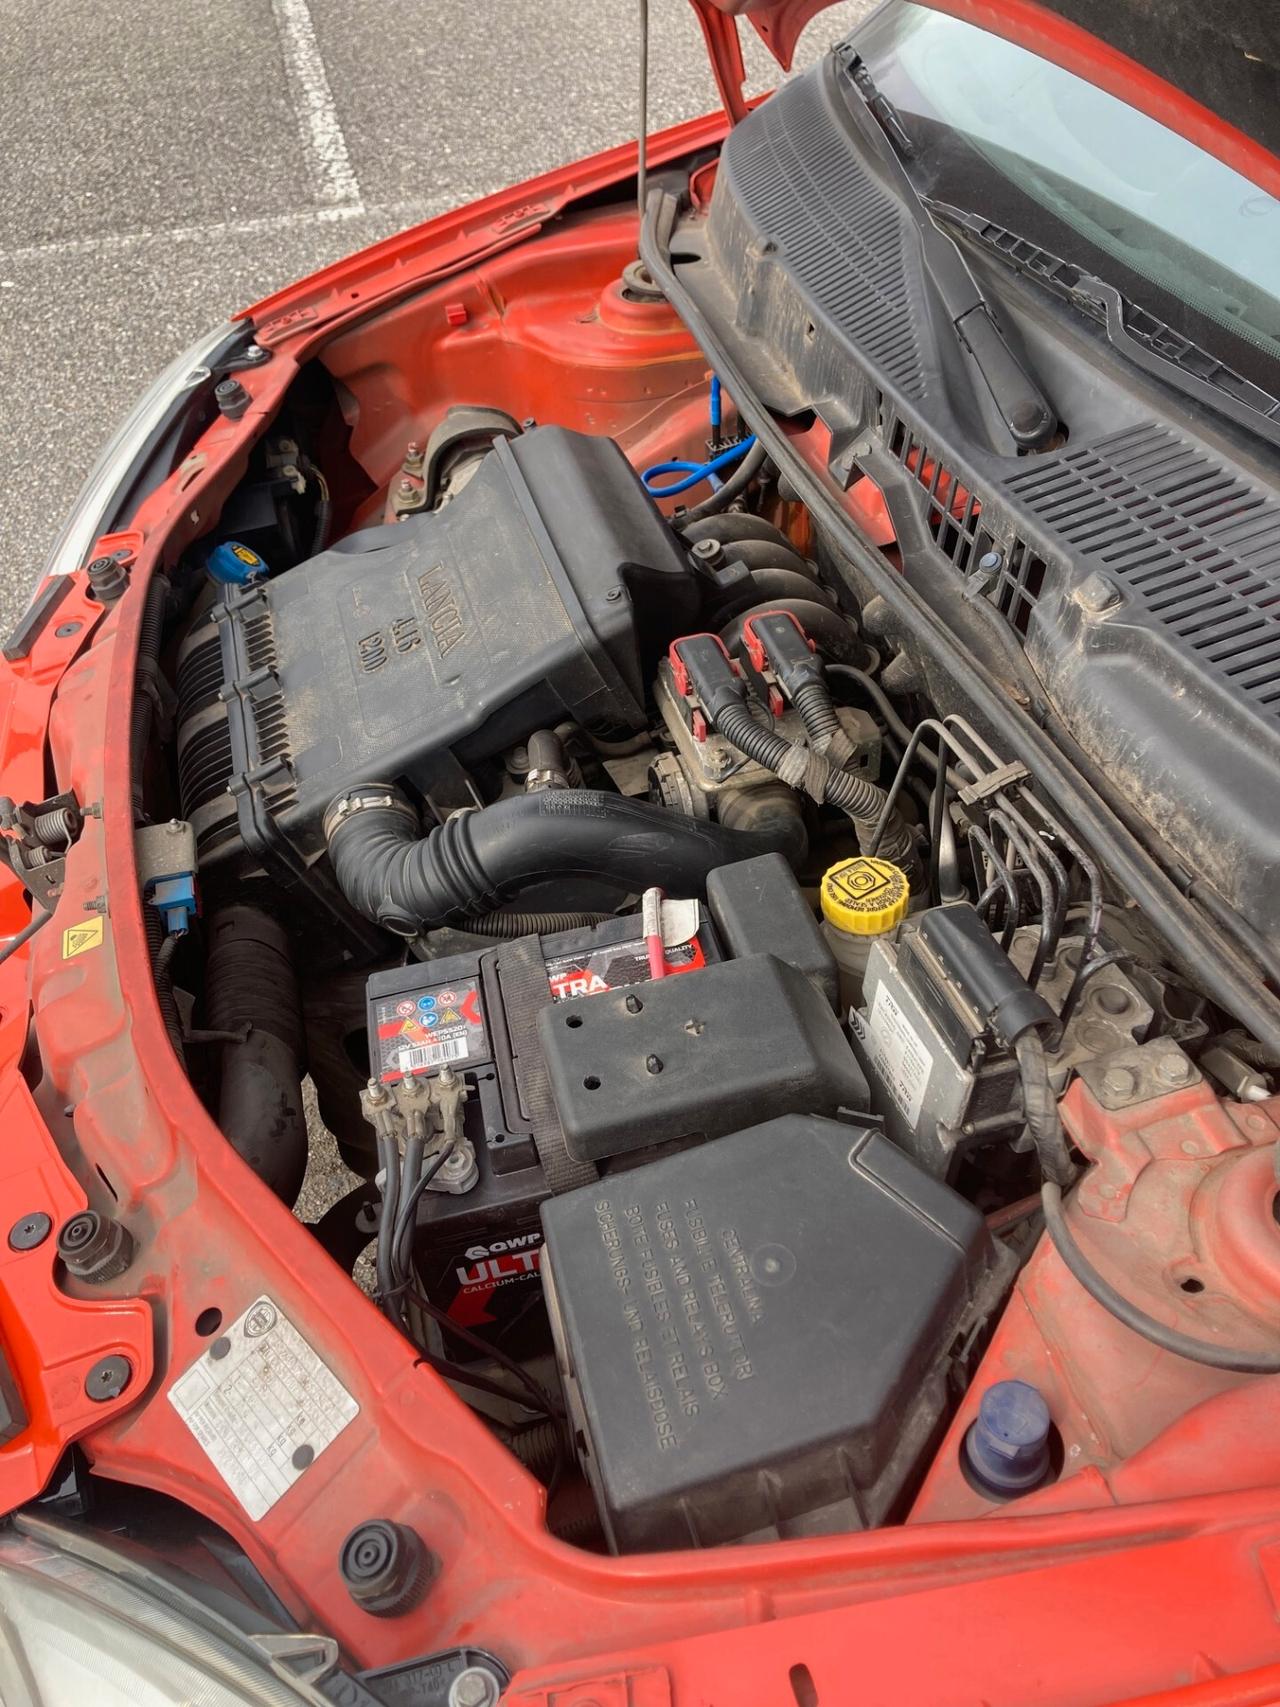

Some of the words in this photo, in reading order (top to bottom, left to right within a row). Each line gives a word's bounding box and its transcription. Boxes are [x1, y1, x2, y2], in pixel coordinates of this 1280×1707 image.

[417, 562, 466, 660] LANCIA
[358, 631, 388, 673] 1200
[665, 944, 694, 955] QUALITY
[552, 976, 609, 1000] TRA
[489, 1232, 540, 1252] QWP
[594, 1199, 631, 1297] SICHERUNGS-
[456, 1248, 540, 1286] ULT
[463, 1272, 542, 1295] CALCIUM-CAL
[721, 1227, 764, 1326] CENTRALINA
[623, 1300, 644, 1333] UND
[656, 1199, 680, 1250] FUSES
[670, 1256, 692, 1286] AND
[703, 1361, 728, 1400] BOX
[639, 1250, 672, 1323] FUSIBLES
[660, 1326, 680, 1347] ET
[670, 1351, 700, 1418] RELAIS
[632, 1337, 677, 1450] RELAISDOSE
